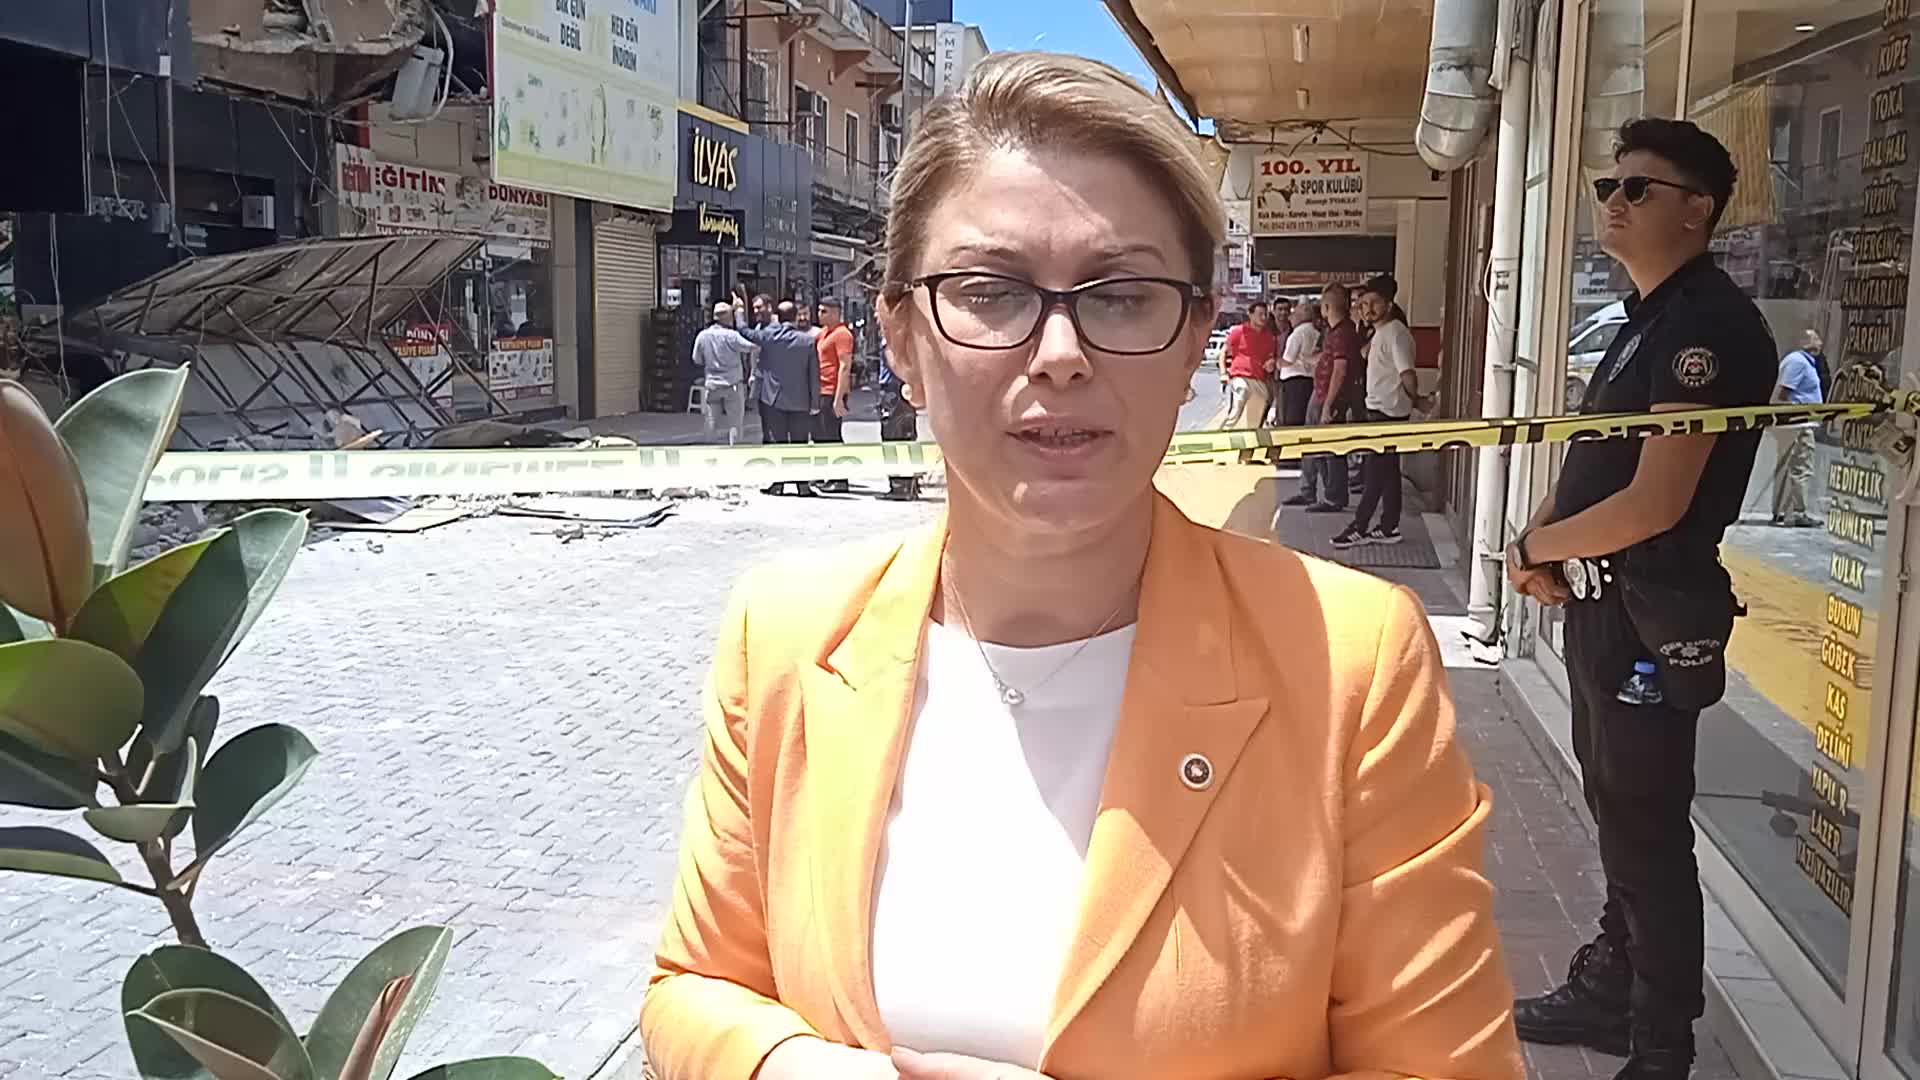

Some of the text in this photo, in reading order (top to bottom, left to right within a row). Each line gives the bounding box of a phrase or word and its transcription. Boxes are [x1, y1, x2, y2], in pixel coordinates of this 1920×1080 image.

[943, 38, 955, 88] MERK
[693, 126, 739, 192] İLYAS
[1261, 158, 1361, 176] 100. YIL
[1300, 175, 1363, 195] SPOR KULÜBÜ
[1829, 458, 1883, 498] HEDİYELİK
[1828, 499, 1873, 547] ÜRÜNLER
[1830, 551, 1864, 591] KULAK
[1828, 595, 1861, 635] BURUN
[1822, 632, 1857, 681] GÖBEK
[1826, 683, 1846, 727] KAŞ
[1810, 808, 1842, 856] LAZER
